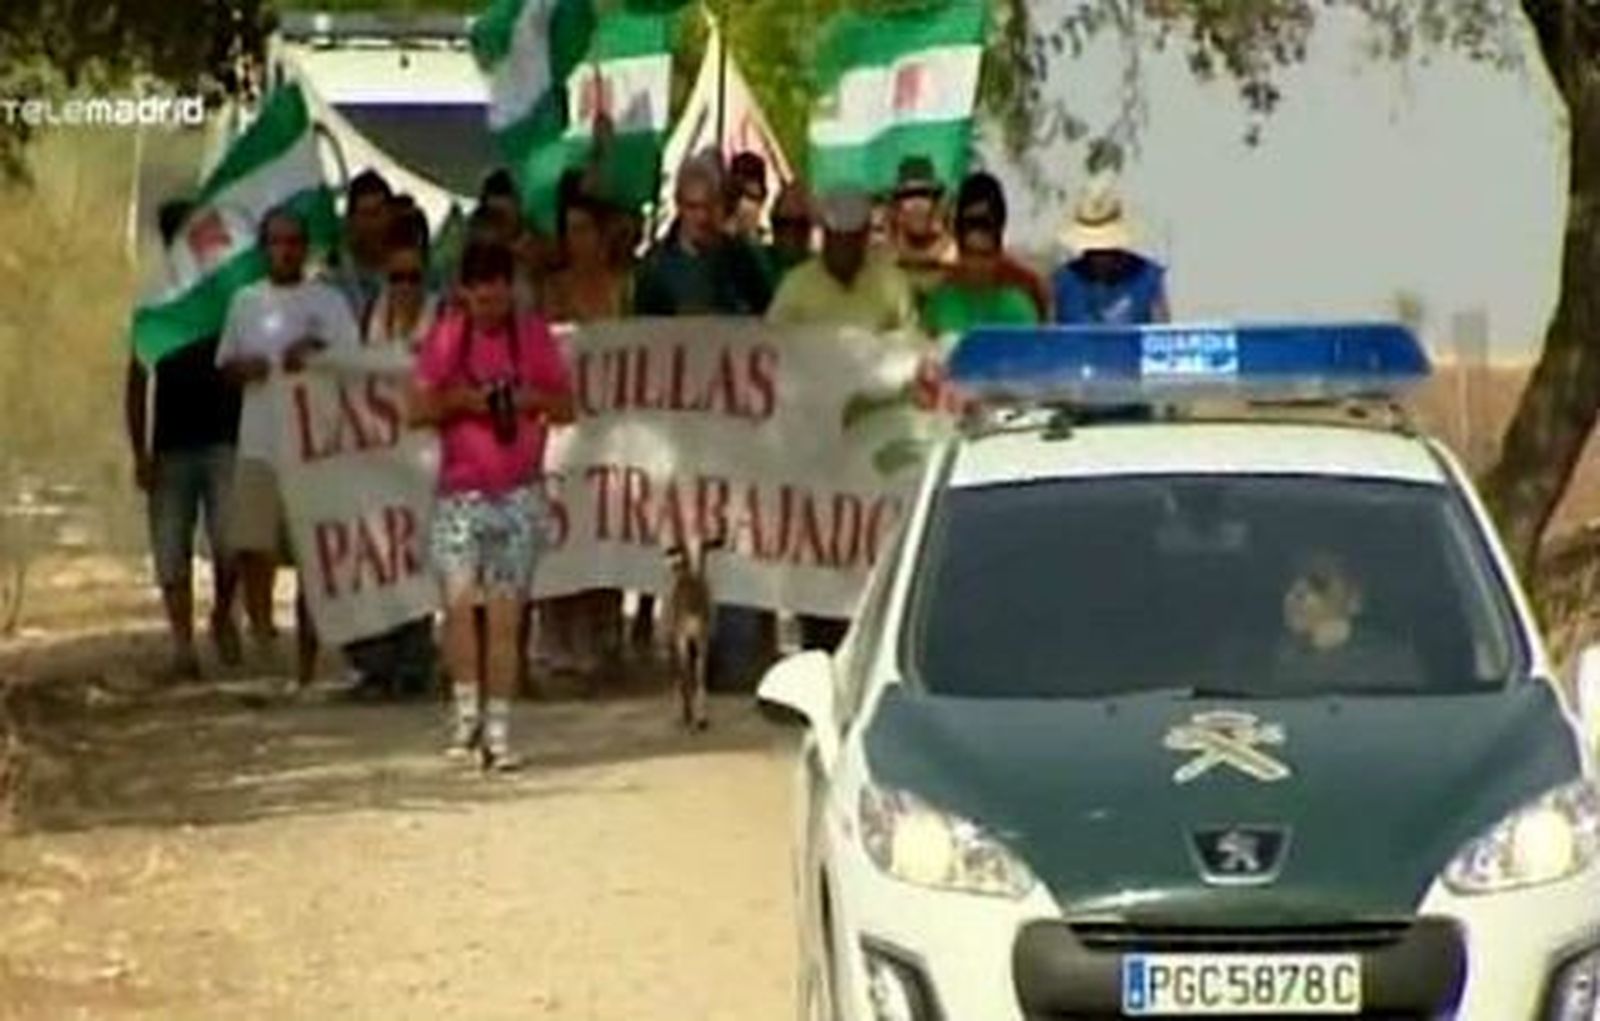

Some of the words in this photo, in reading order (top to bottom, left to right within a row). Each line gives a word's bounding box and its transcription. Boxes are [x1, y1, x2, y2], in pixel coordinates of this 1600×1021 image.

[292, 374, 401, 462] LAS
[577, 345, 780, 420] UILLAS
[314, 502, 424, 596] PAR
